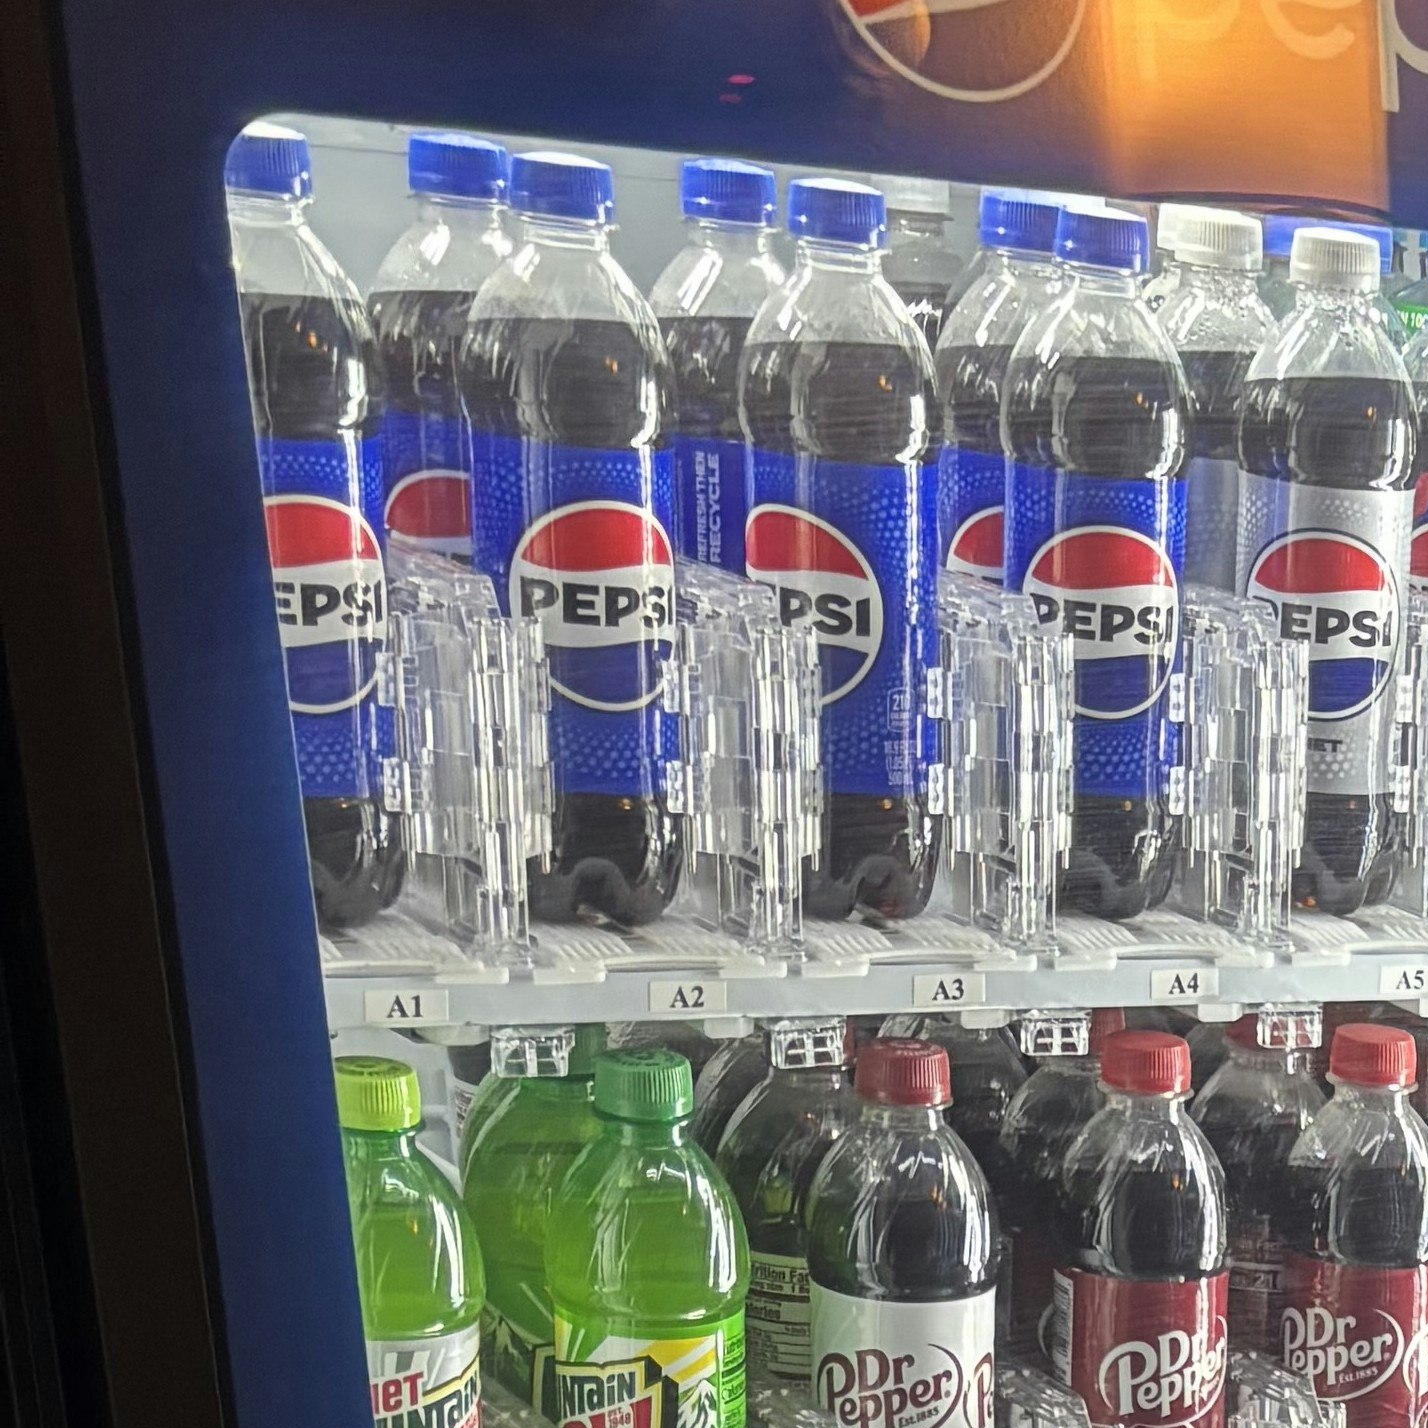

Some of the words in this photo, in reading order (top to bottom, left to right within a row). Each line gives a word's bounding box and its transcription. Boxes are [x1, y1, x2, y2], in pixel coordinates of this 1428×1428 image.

[710, 453, 721, 564] RECYCLE
[275, 581, 383, 628] EPSI
[519, 575, 673, 628] PEPSI
[779, 586, 871, 637] PSI
[670, 984, 705, 1009] A2
[932, 978, 964, 1001] A3
[1169, 972, 1200, 995] A4
[1396, 967, 1426, 991] A5
[386, 994, 424, 1019] A1
[1306, 1308, 1356, 1348] Dr
[856, 1349, 915, 1393] Dr
